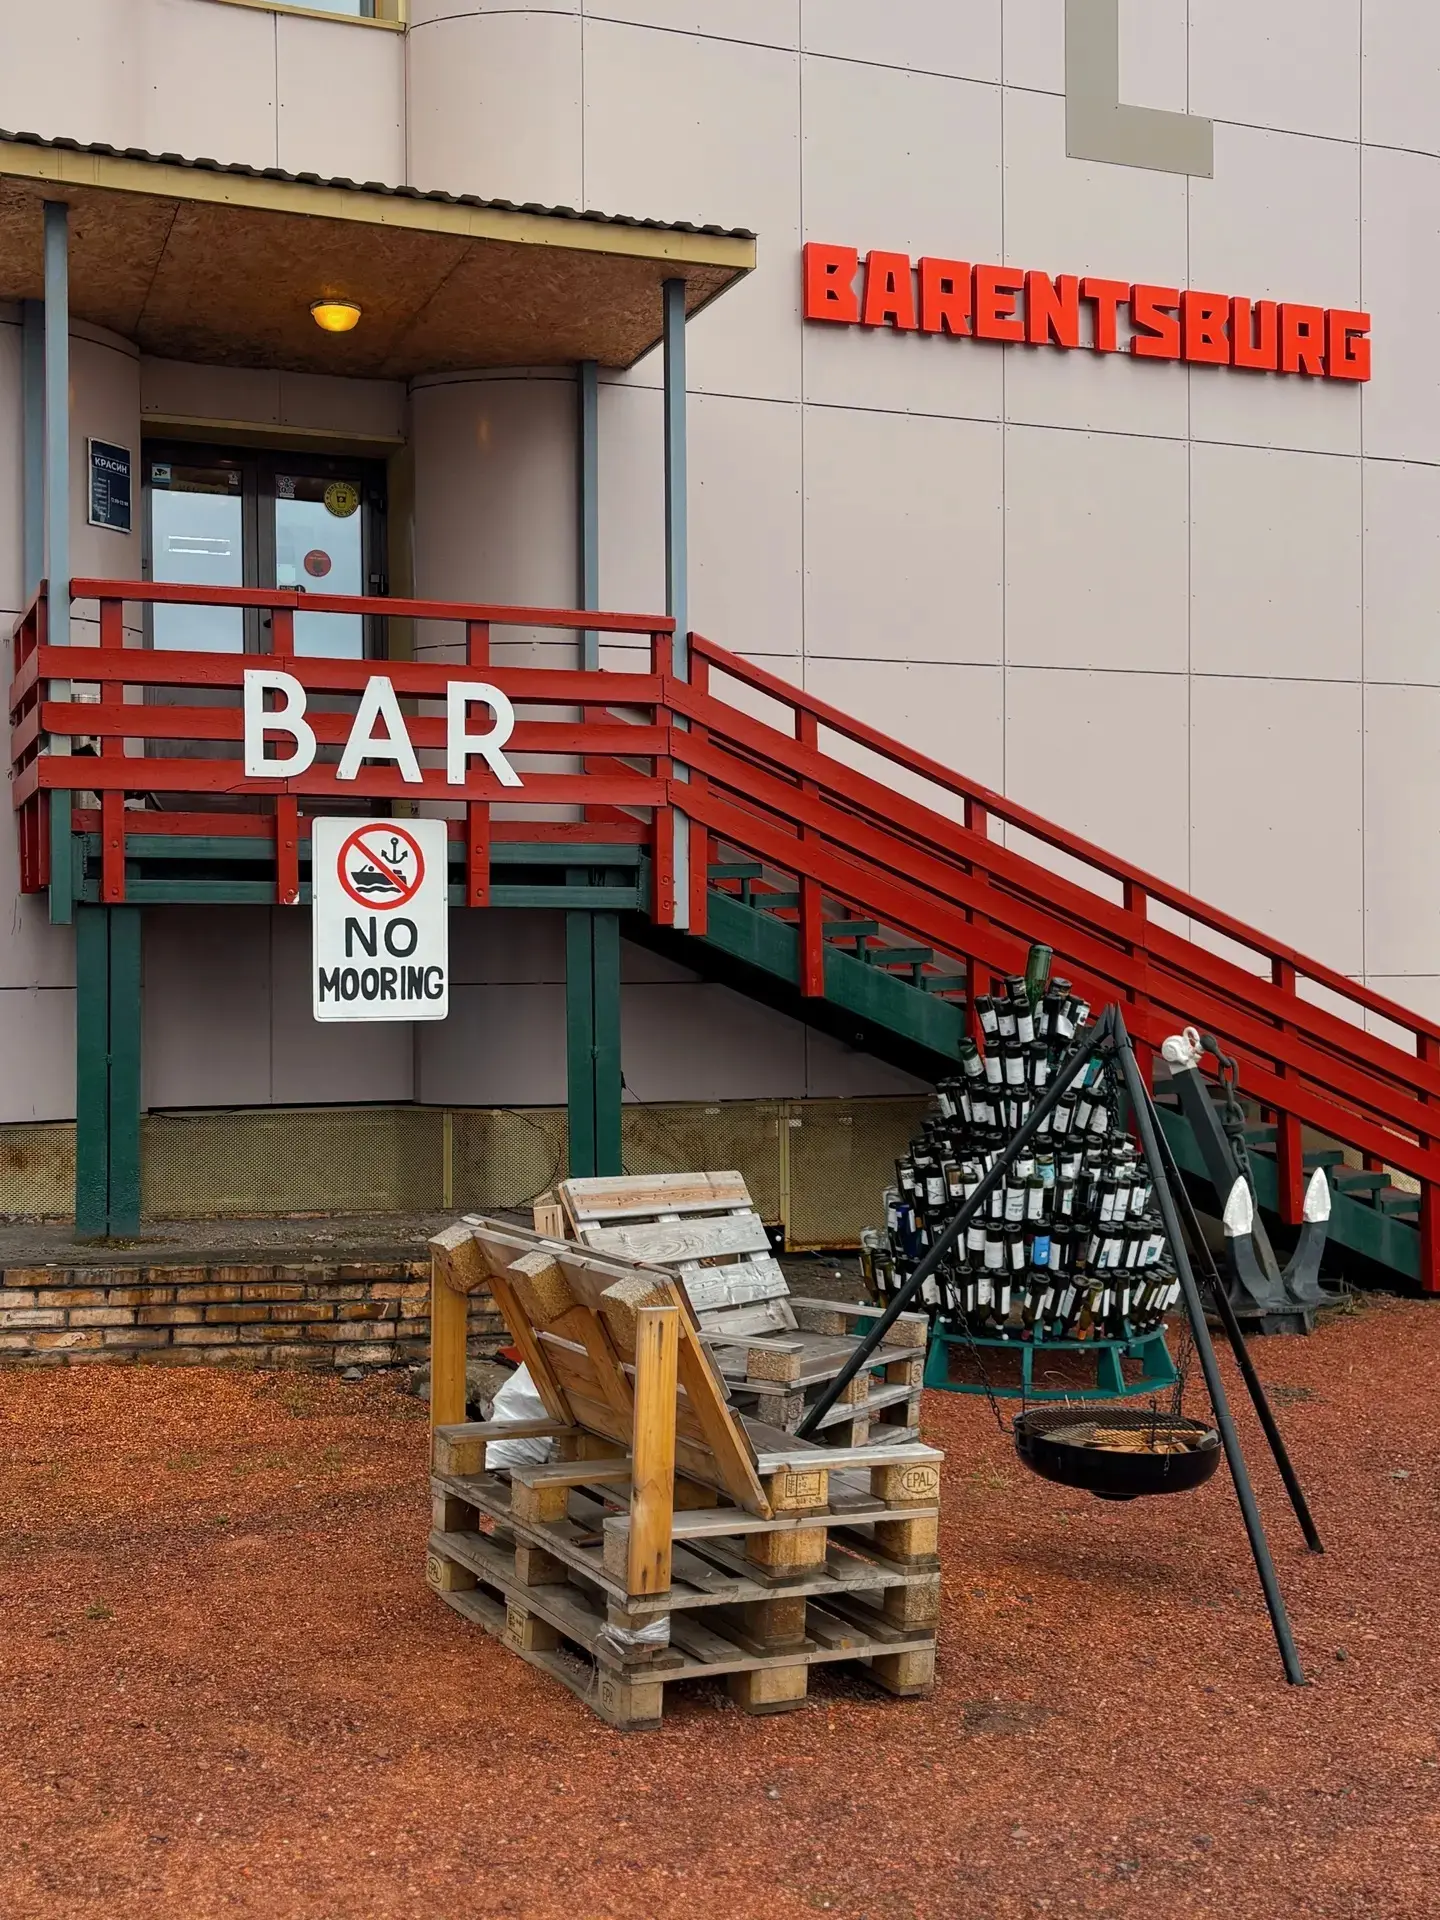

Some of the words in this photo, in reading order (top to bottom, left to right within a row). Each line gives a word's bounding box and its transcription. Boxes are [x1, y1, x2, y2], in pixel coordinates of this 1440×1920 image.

[803, 242, 1370, 382] BARENTSBURG
[94, 457, 128, 474] КРАСИН
[244, 669, 524, 787] BAR
[345, 917, 418, 957] NO
[319, 966, 443, 1002] MOORING
[907, 1472, 932, 1488] EPAL
